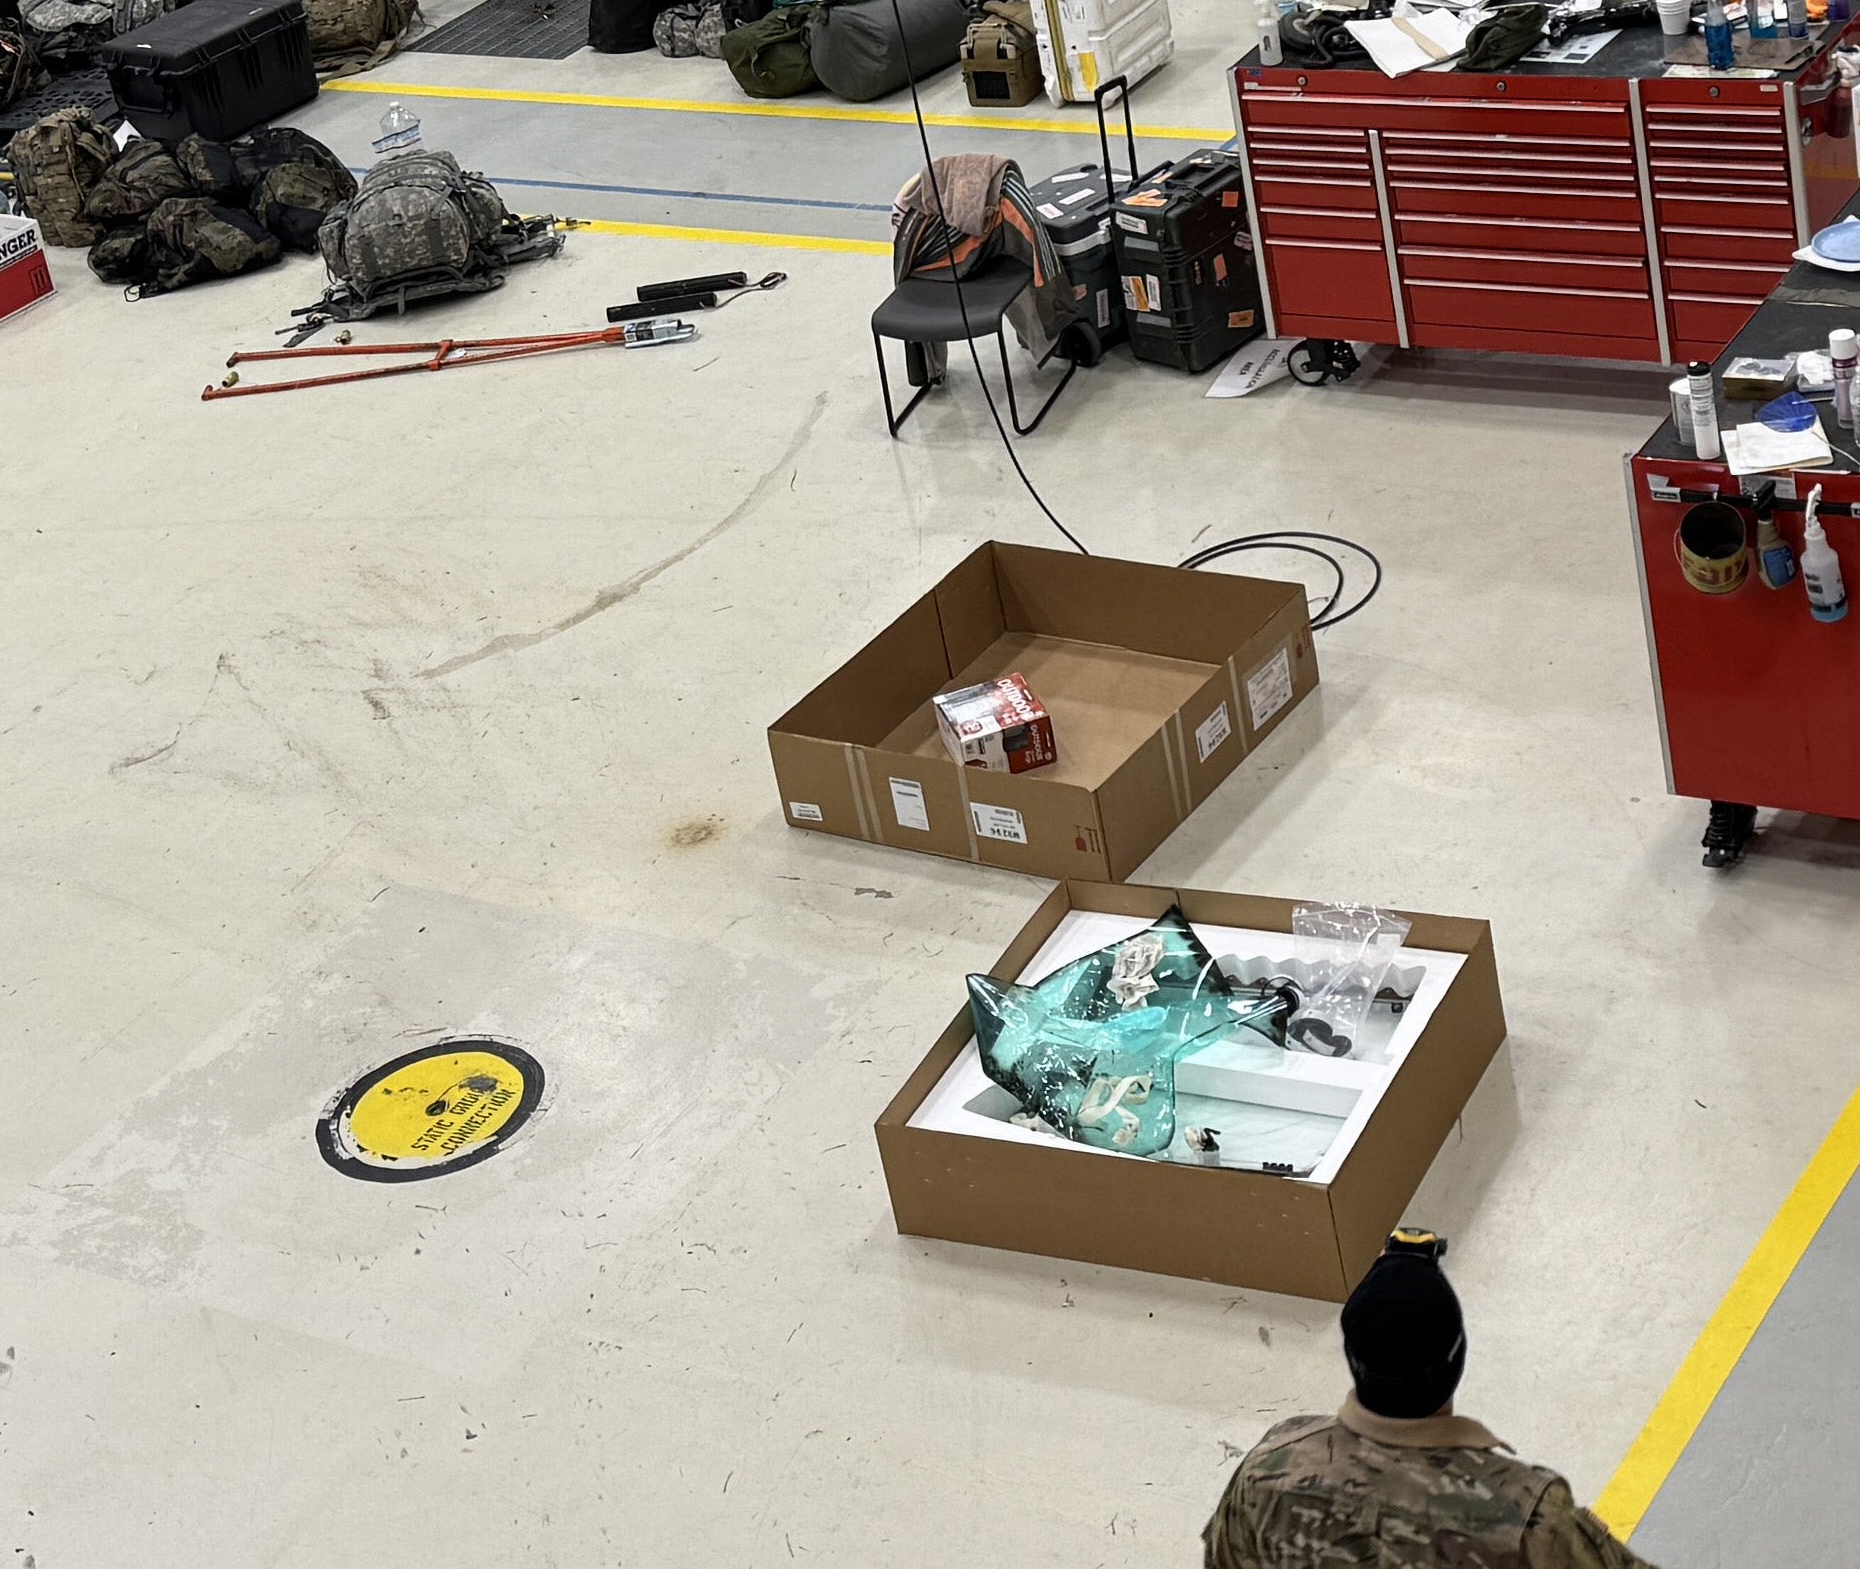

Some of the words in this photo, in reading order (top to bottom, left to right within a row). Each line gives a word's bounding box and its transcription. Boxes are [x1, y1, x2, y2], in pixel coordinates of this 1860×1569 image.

[411, 1119, 454, 1151] STATIC
[449, 1088, 485, 1116] GROU
[442, 1088, 517, 1154] CONNECTION
